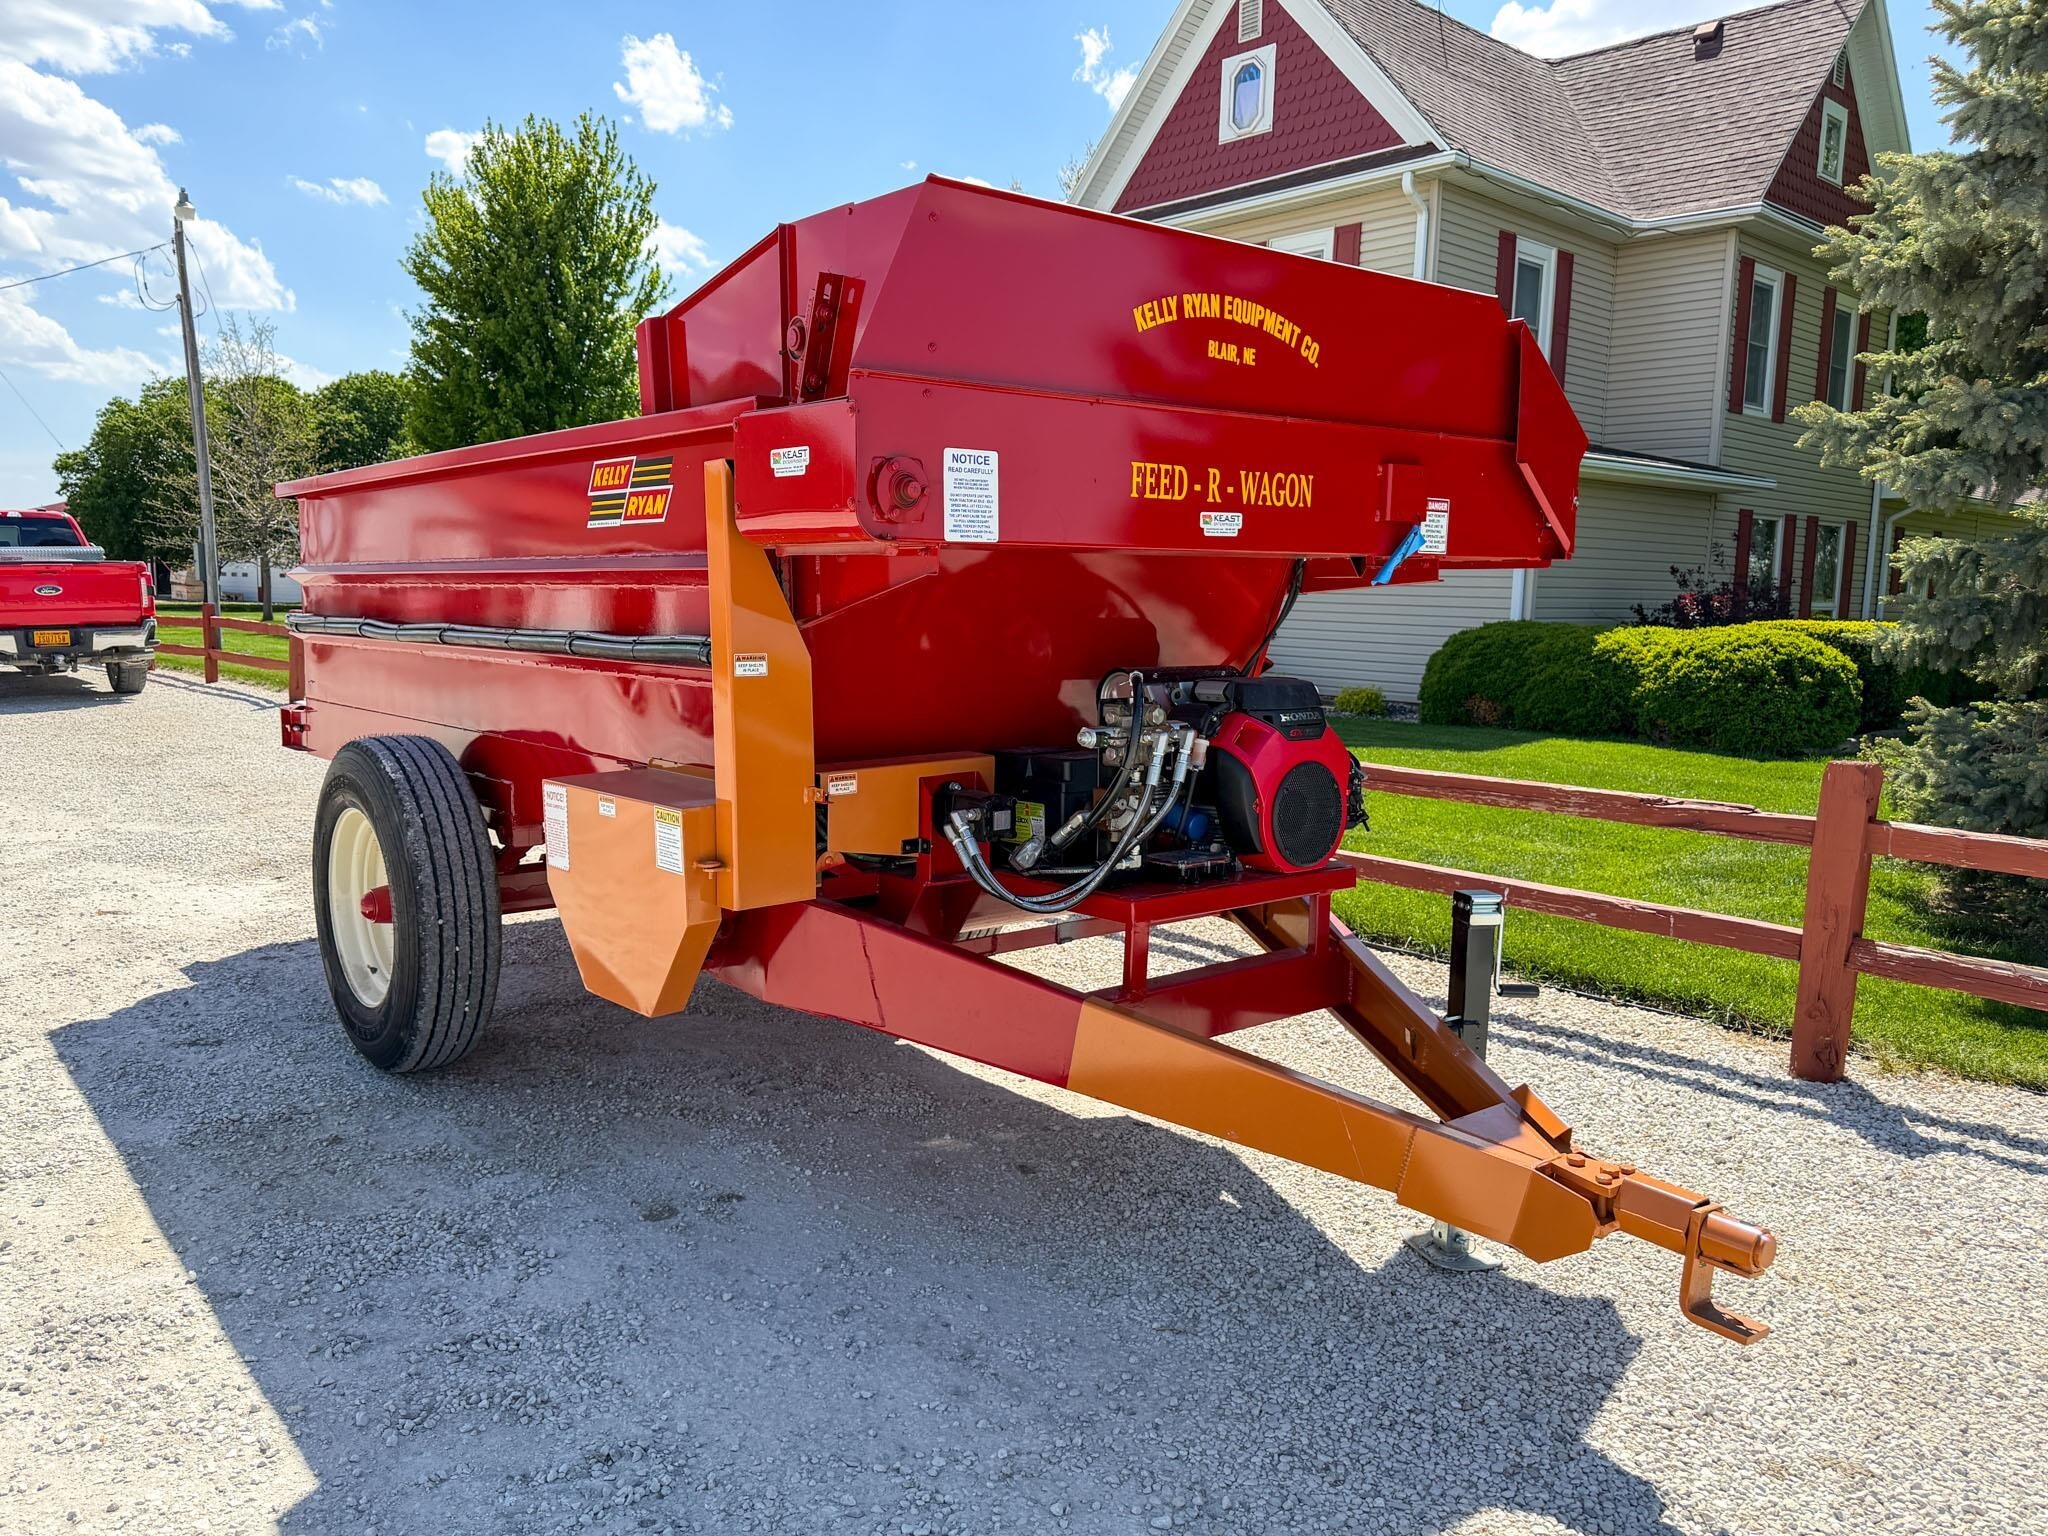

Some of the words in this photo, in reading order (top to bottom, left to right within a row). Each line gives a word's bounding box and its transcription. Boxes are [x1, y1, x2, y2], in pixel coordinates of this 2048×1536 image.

[1133, 295, 1178, 332] KELLY
[1183, 293, 1220, 318] RYAN
[1224, 295, 1301, 348] EQUIPMENT
[1300, 335, 1320, 369] CO.
[1208, 340, 1240, 365] BLAIR,
[1243, 347, 1256, 366] NE
[782, 449, 808, 459] KEAST
[952, 453, 991, 466] NOTICE
[593, 464, 630, 487] KELLY
[963, 467, 994, 475] CAREFULLY
[1130, 461, 1188, 501] FEED
[1207, 468, 1222, 503] R
[1240, 470, 1314, 508] WAGON
[626, 493, 667, 516] RYAN
[1213, 514, 1241, 522] KEAST
[1280, 711, 1322, 722] HONDA
[656, 809, 680, 824] CAUTION
